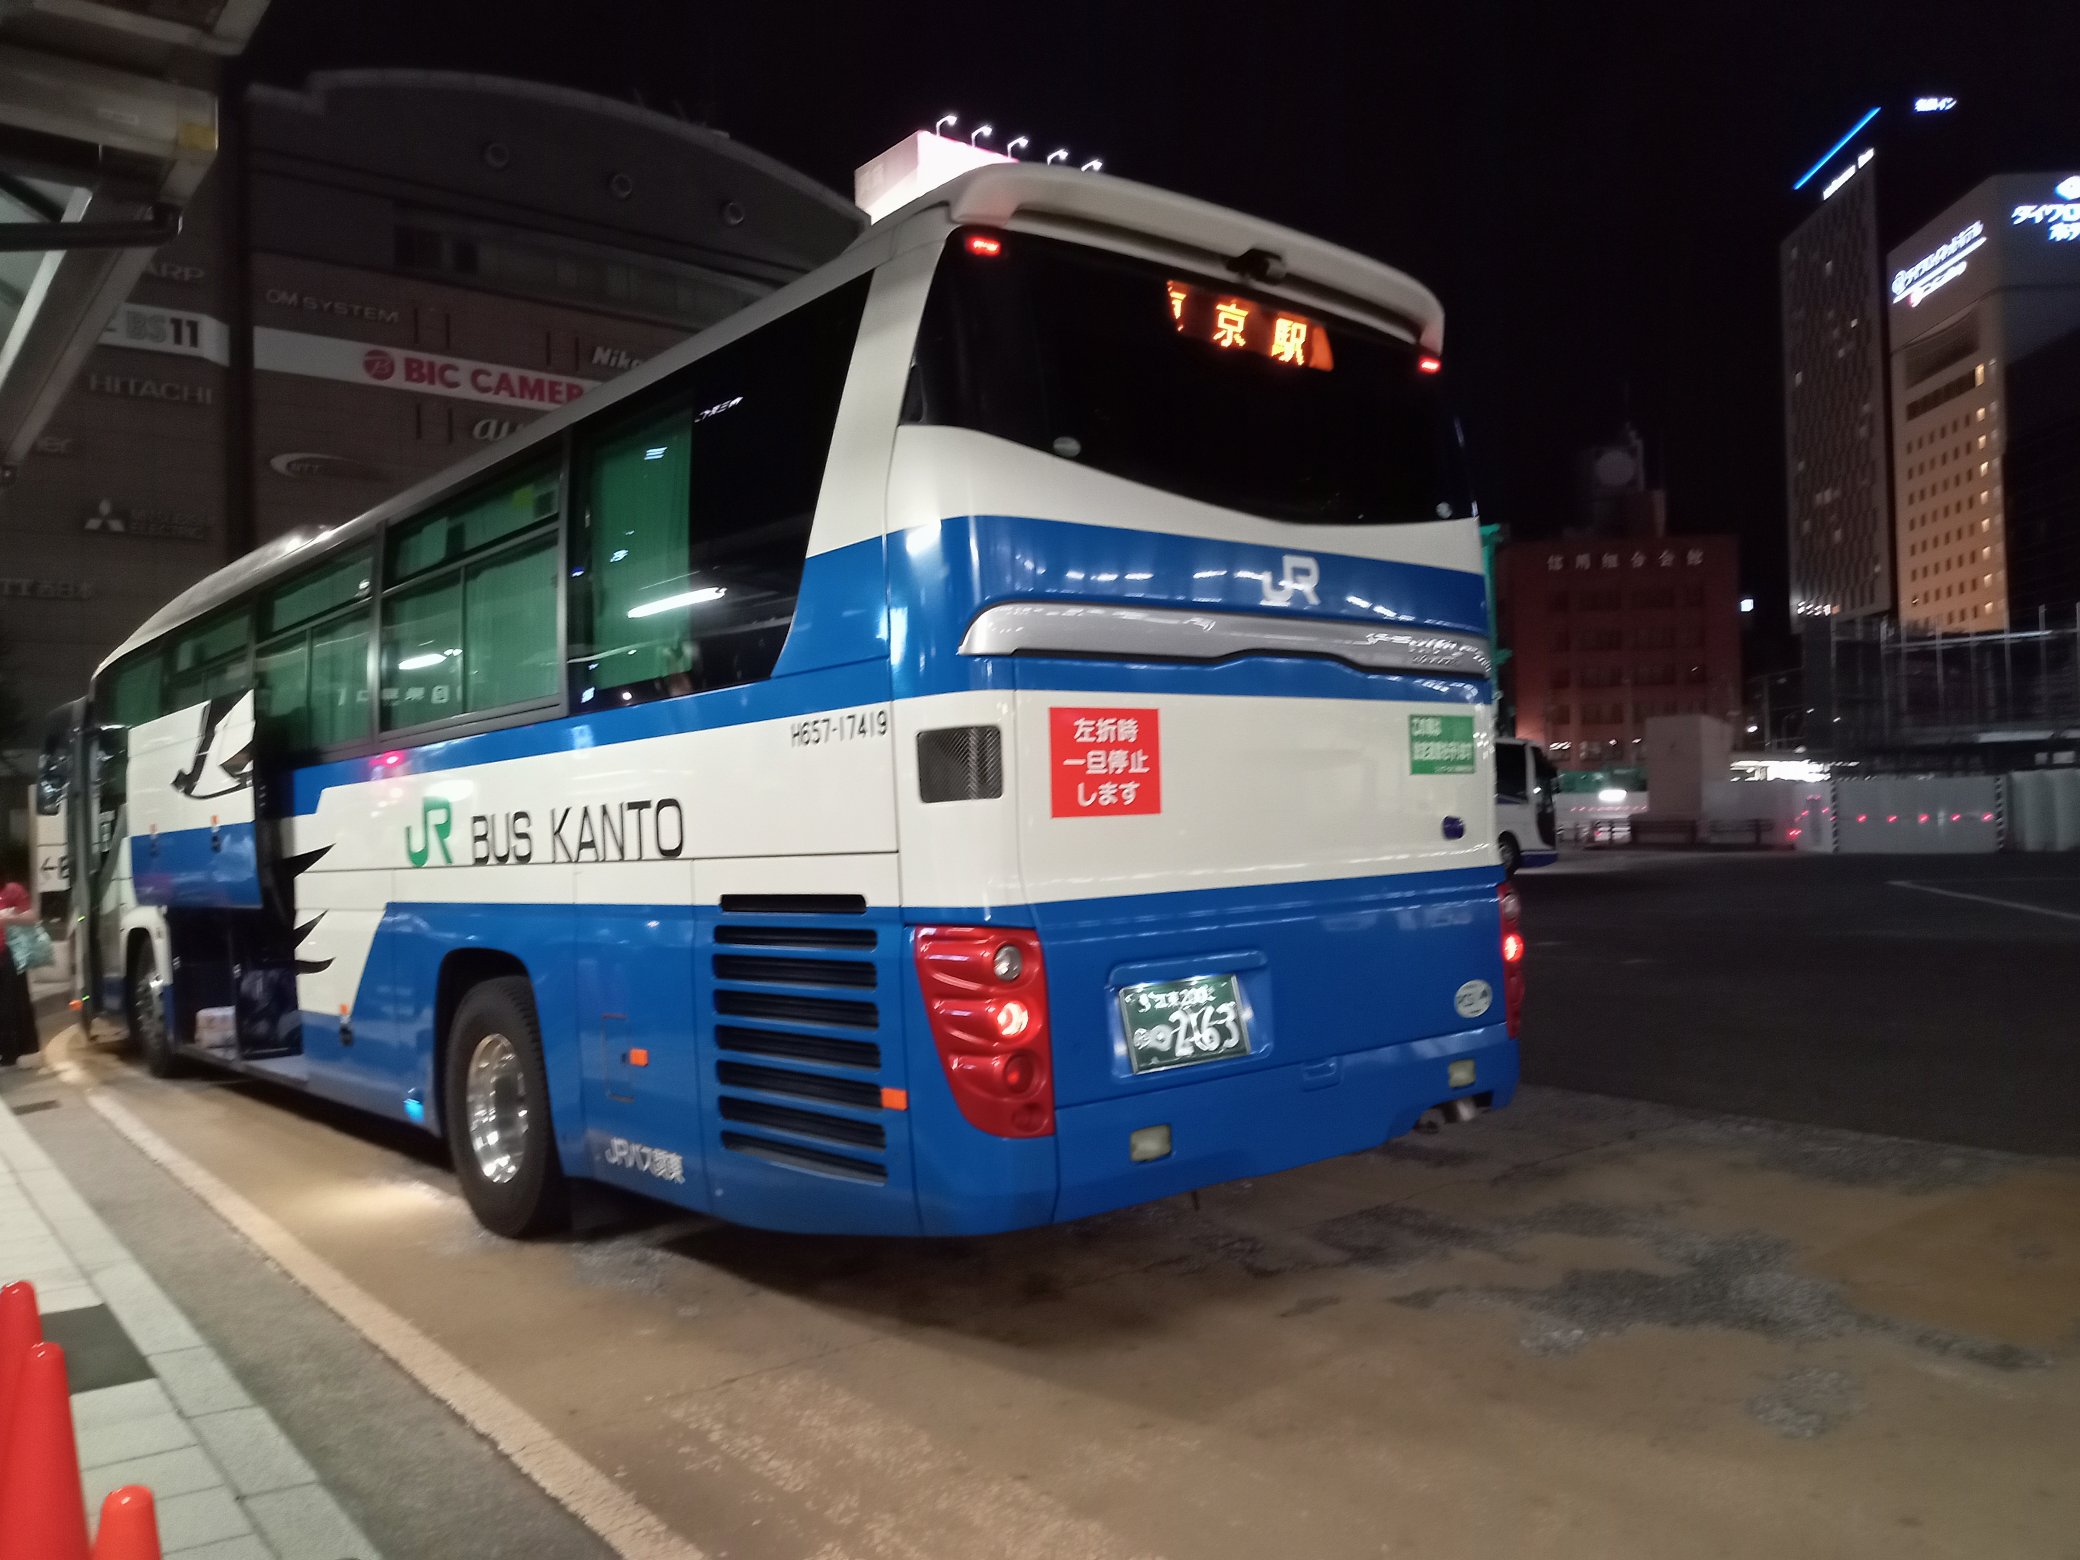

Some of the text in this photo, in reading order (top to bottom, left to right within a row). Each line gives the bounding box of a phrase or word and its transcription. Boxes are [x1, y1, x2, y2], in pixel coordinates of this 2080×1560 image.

[303, 296, 400, 324] SYSTEM
[126, 309, 199, 348] BS11
[404, 357, 460, 389] BIC
[89, 374, 213, 405] HITACHI
[1261, 554, 1321, 606] JR
[791, 709, 888, 748] H657-17419
[1073, 717, 1139, 743] 左折時
[1063, 748, 1150, 774] 一旦停止
[1077, 780, 1140, 807] します
[406, 796, 685, 867] JR BUS KANTO
